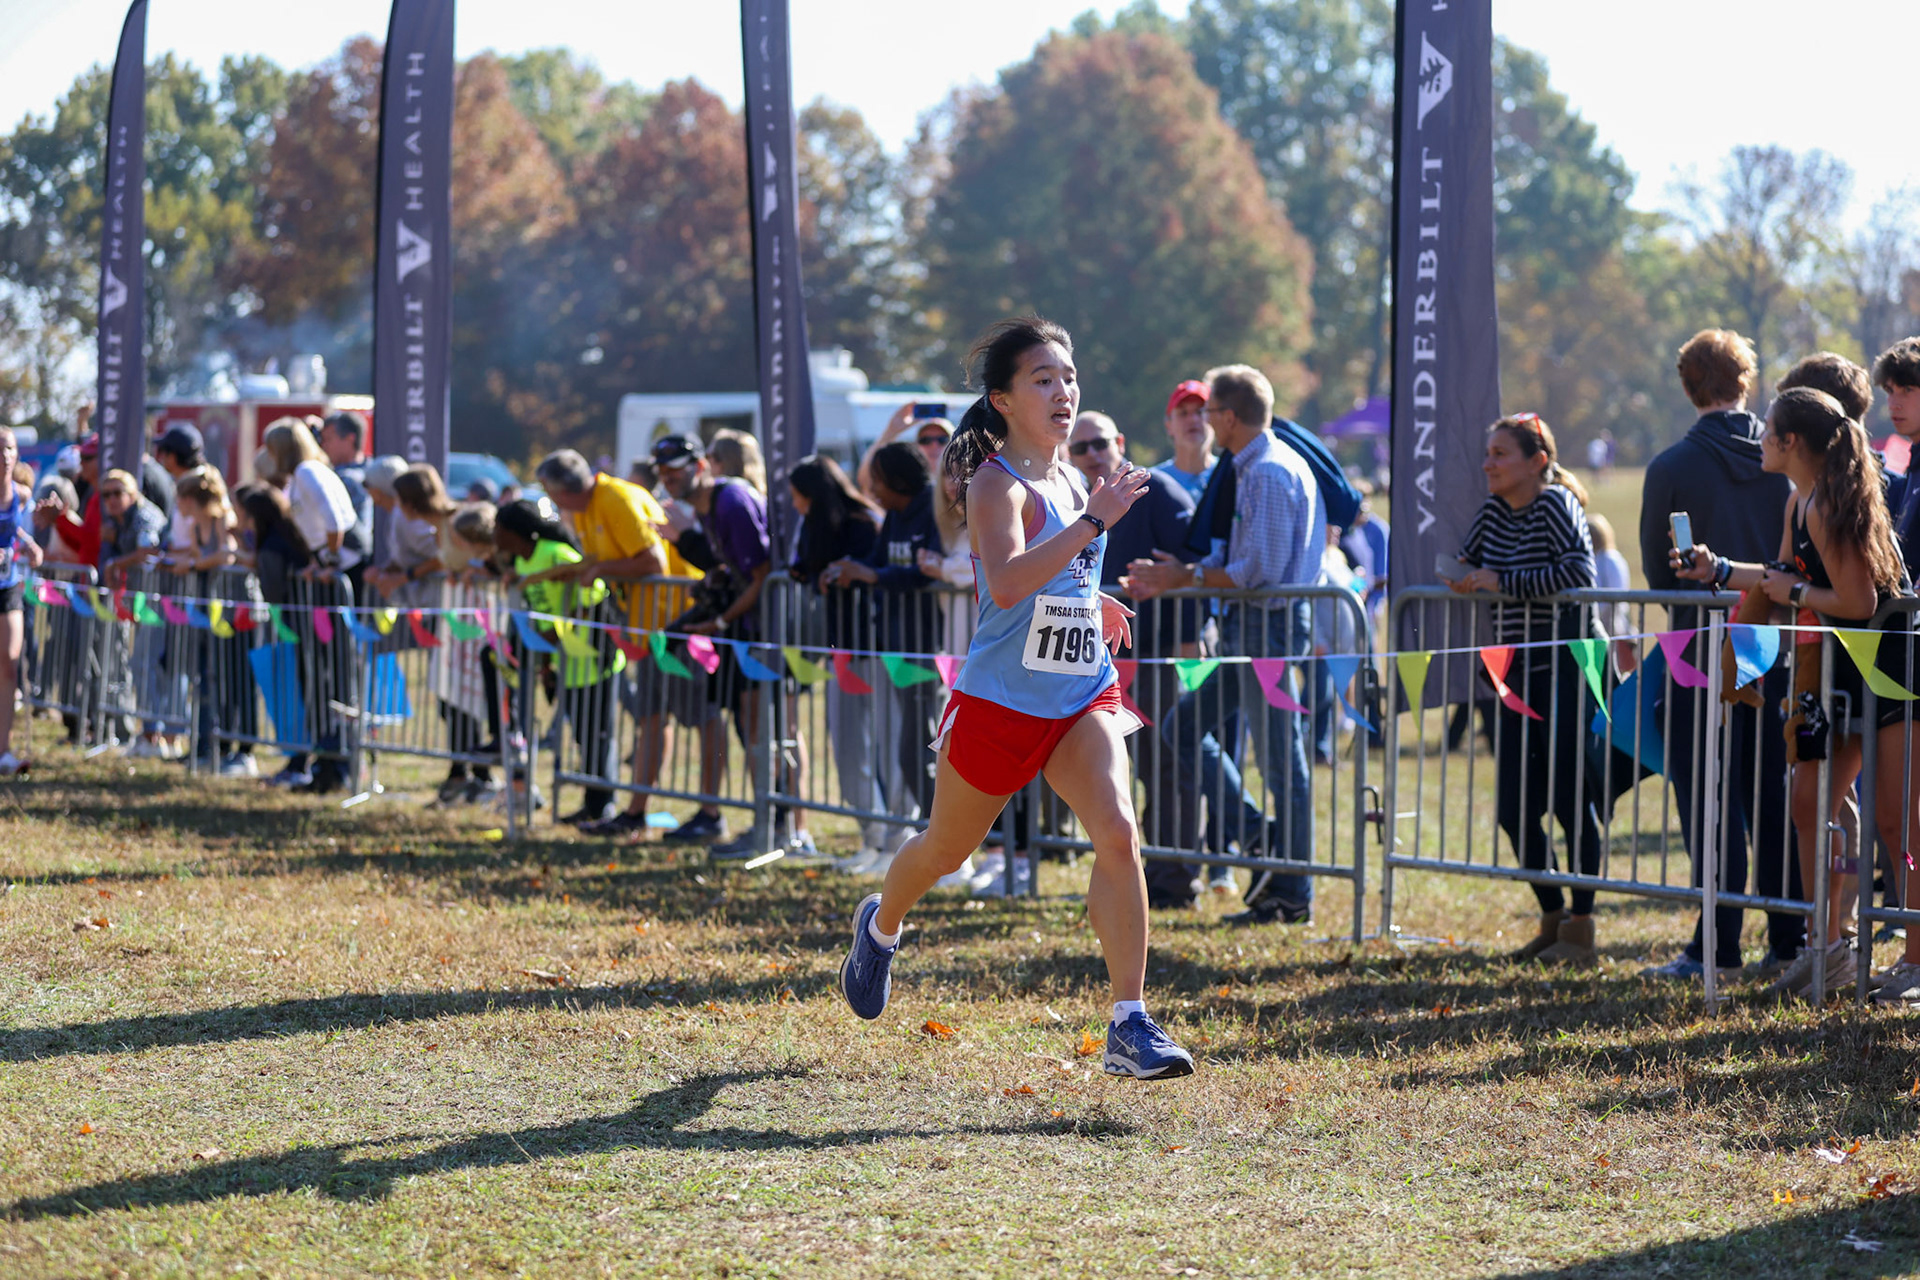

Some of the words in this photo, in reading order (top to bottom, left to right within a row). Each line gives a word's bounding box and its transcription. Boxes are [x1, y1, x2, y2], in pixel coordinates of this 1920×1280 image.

[404, 53, 425, 210] HEALTH
[405, 293, 426, 461] DERBILT
[1412, 147, 1443, 536] VANDERBILT
[1037, 625, 1096, 664] 1196
[1045, 605, 1072, 618] TMSAA
[1073, 607, 1090, 619] STATE
